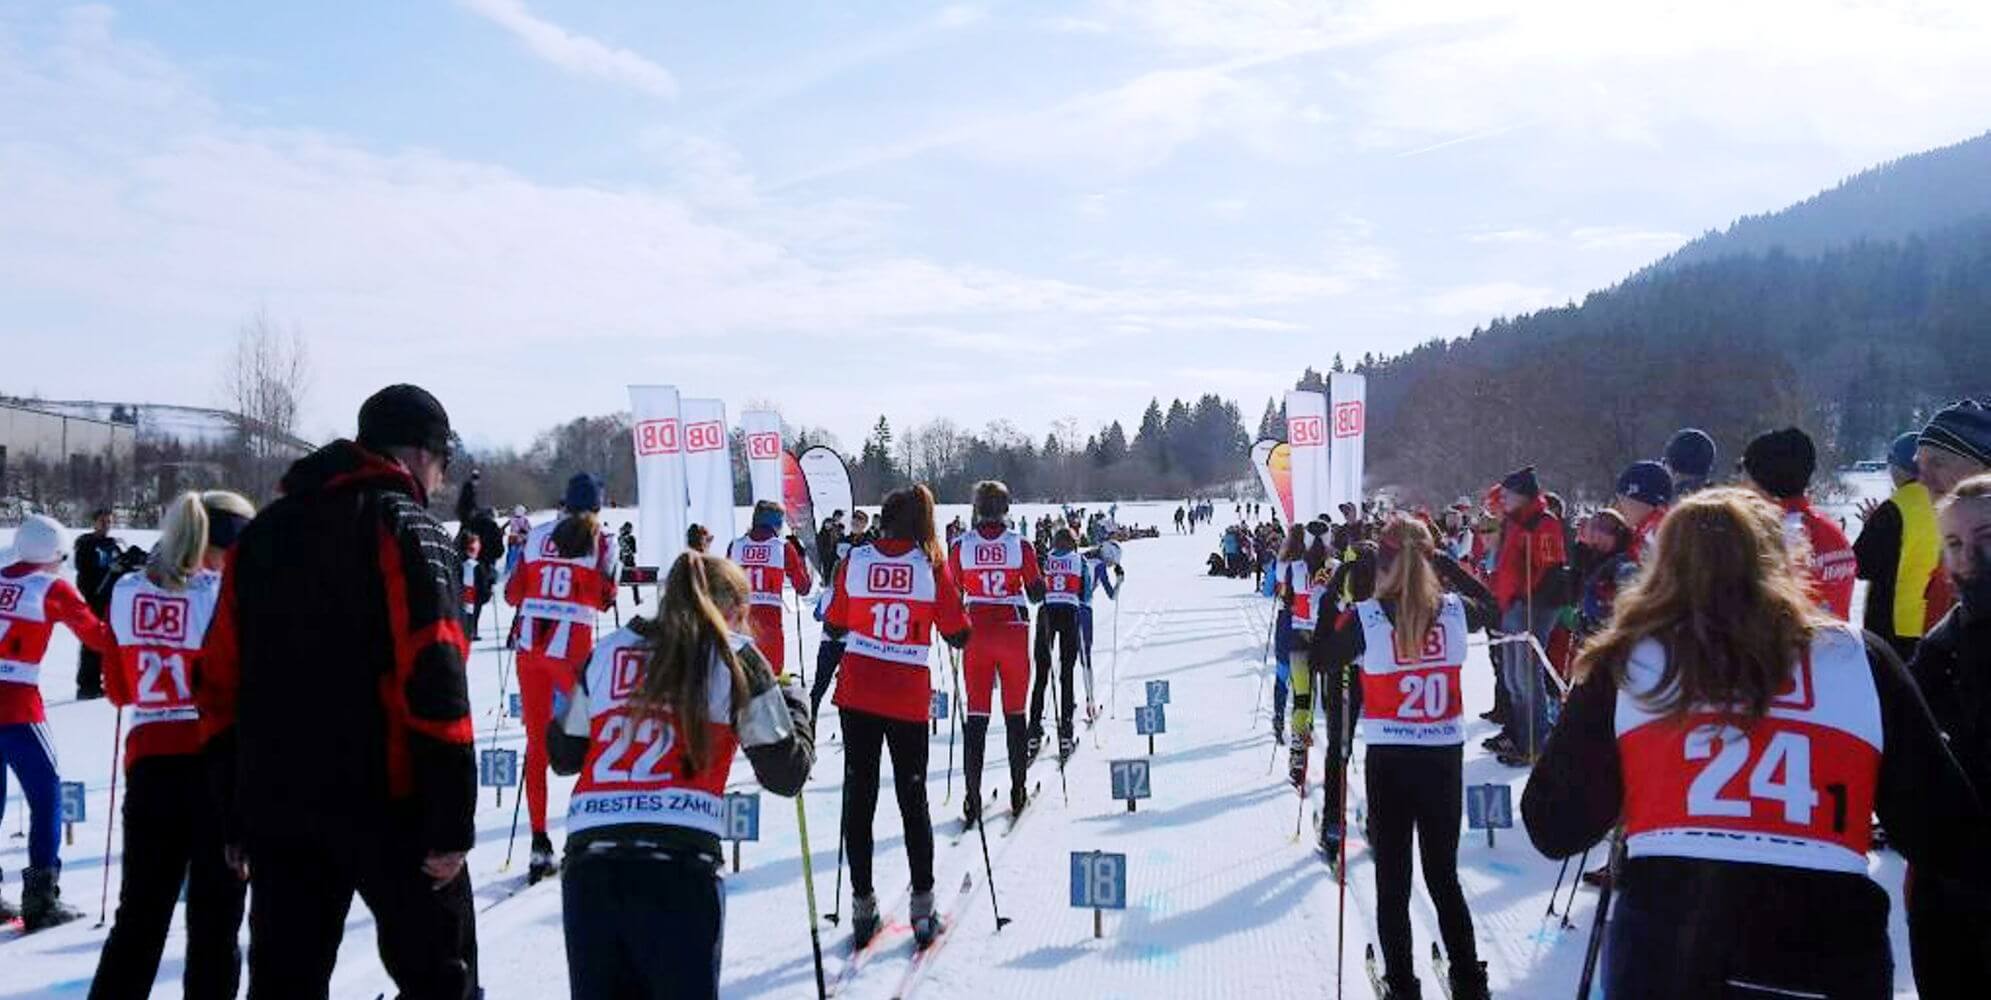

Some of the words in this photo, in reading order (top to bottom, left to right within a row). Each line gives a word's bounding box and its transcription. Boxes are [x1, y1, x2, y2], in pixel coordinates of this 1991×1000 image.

[979, 546, 1002, 562] DB
[539, 565, 573, 599] 16
[873, 567, 908, 589] DB
[979, 570, 1008, 597] 12
[1053, 574, 1067, 591] 8
[139, 601, 180, 634] DB
[870, 602, 910, 641] 18
[137, 651, 191, 702] 21
[1397, 672, 1448, 719] 20
[1144, 707, 1156, 733] 8
[592, 713, 678, 783] 22
[1112, 762, 1148, 796] 12
[1683, 724, 1820, 826] 24
[584, 795, 663, 815] BESTES
[1826, 782, 1848, 833] 1
[1079, 855, 1117, 905] 18
